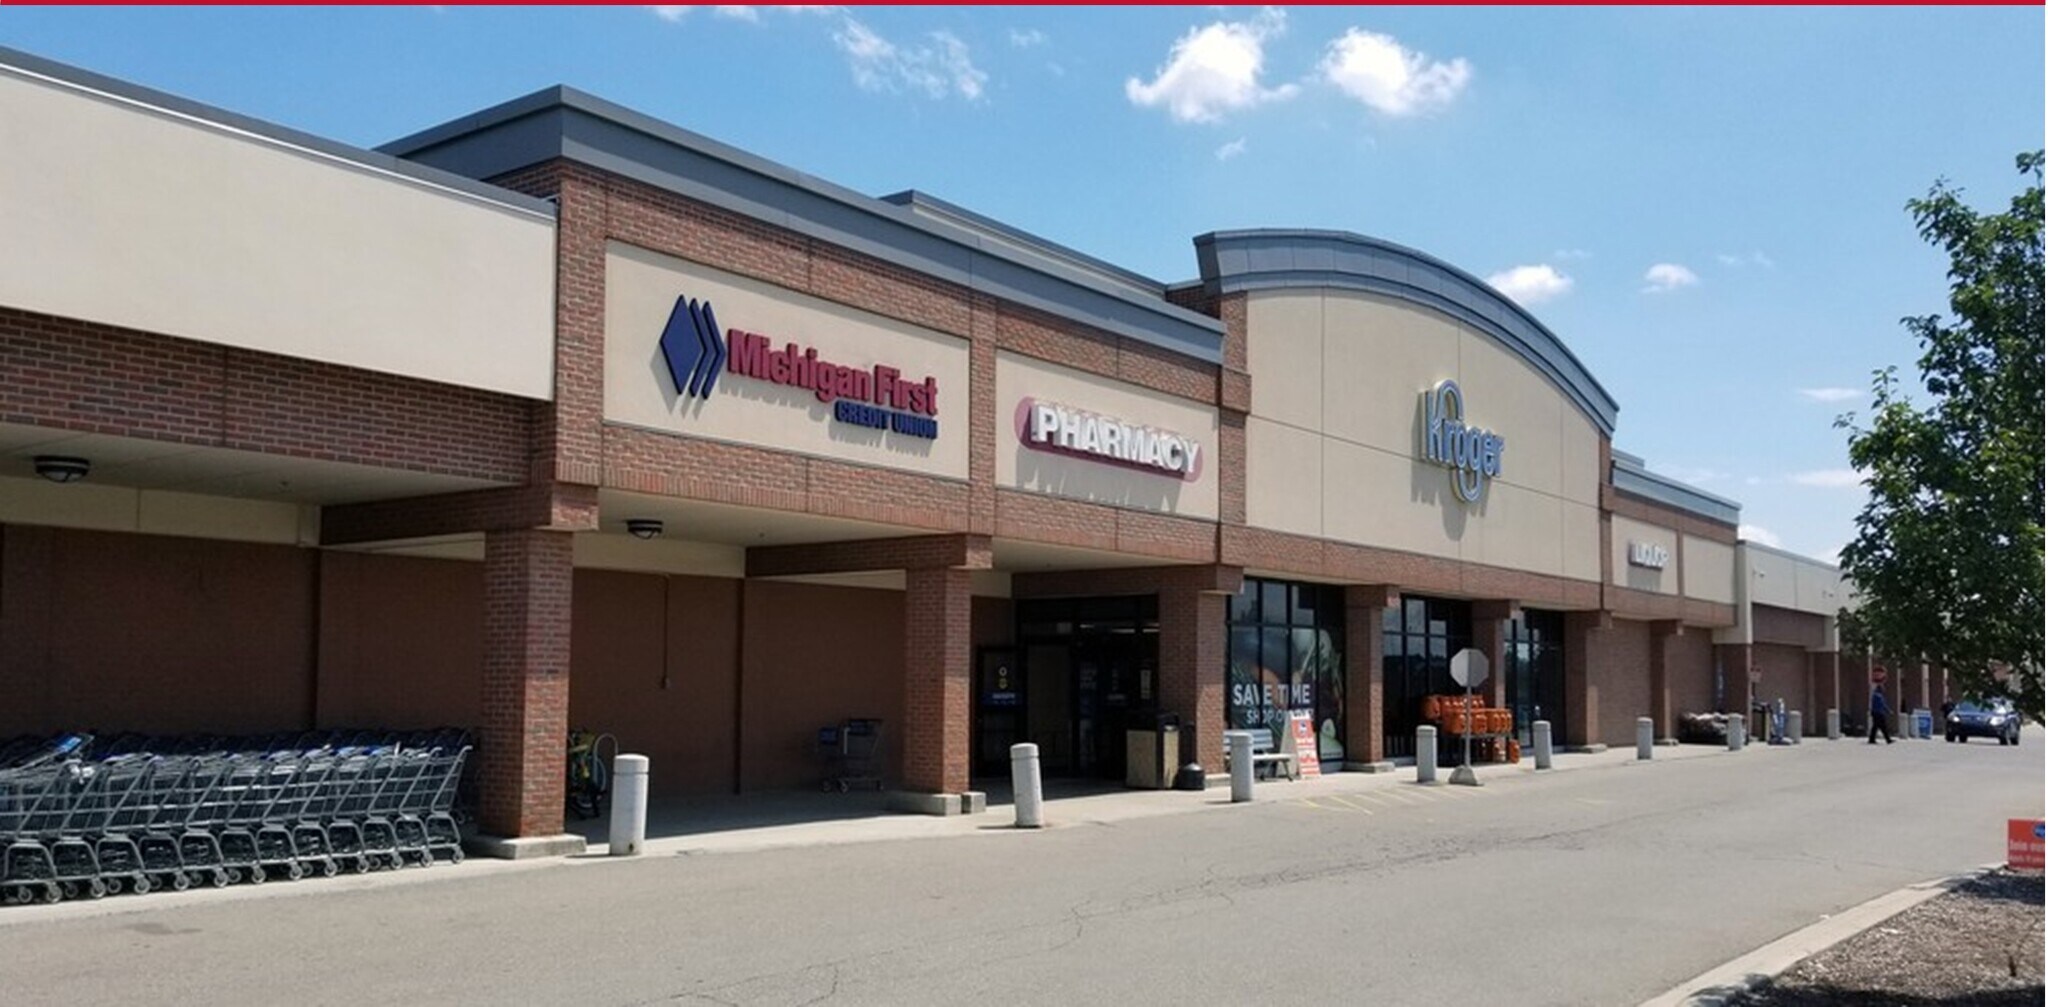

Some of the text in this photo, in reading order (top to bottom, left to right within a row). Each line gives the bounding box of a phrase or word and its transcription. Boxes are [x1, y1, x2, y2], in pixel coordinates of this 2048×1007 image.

[727, 328, 938, 416] Michigan First
[834, 400, 938, 440] CREDIT UNION
[1031, 403, 1199, 474] PHARMACY
[1425, 379, 1505, 501] Kroger
[1233, 683, 1311, 706] SAVE TIME
[1246, 709, 1274, 724] SHOP
